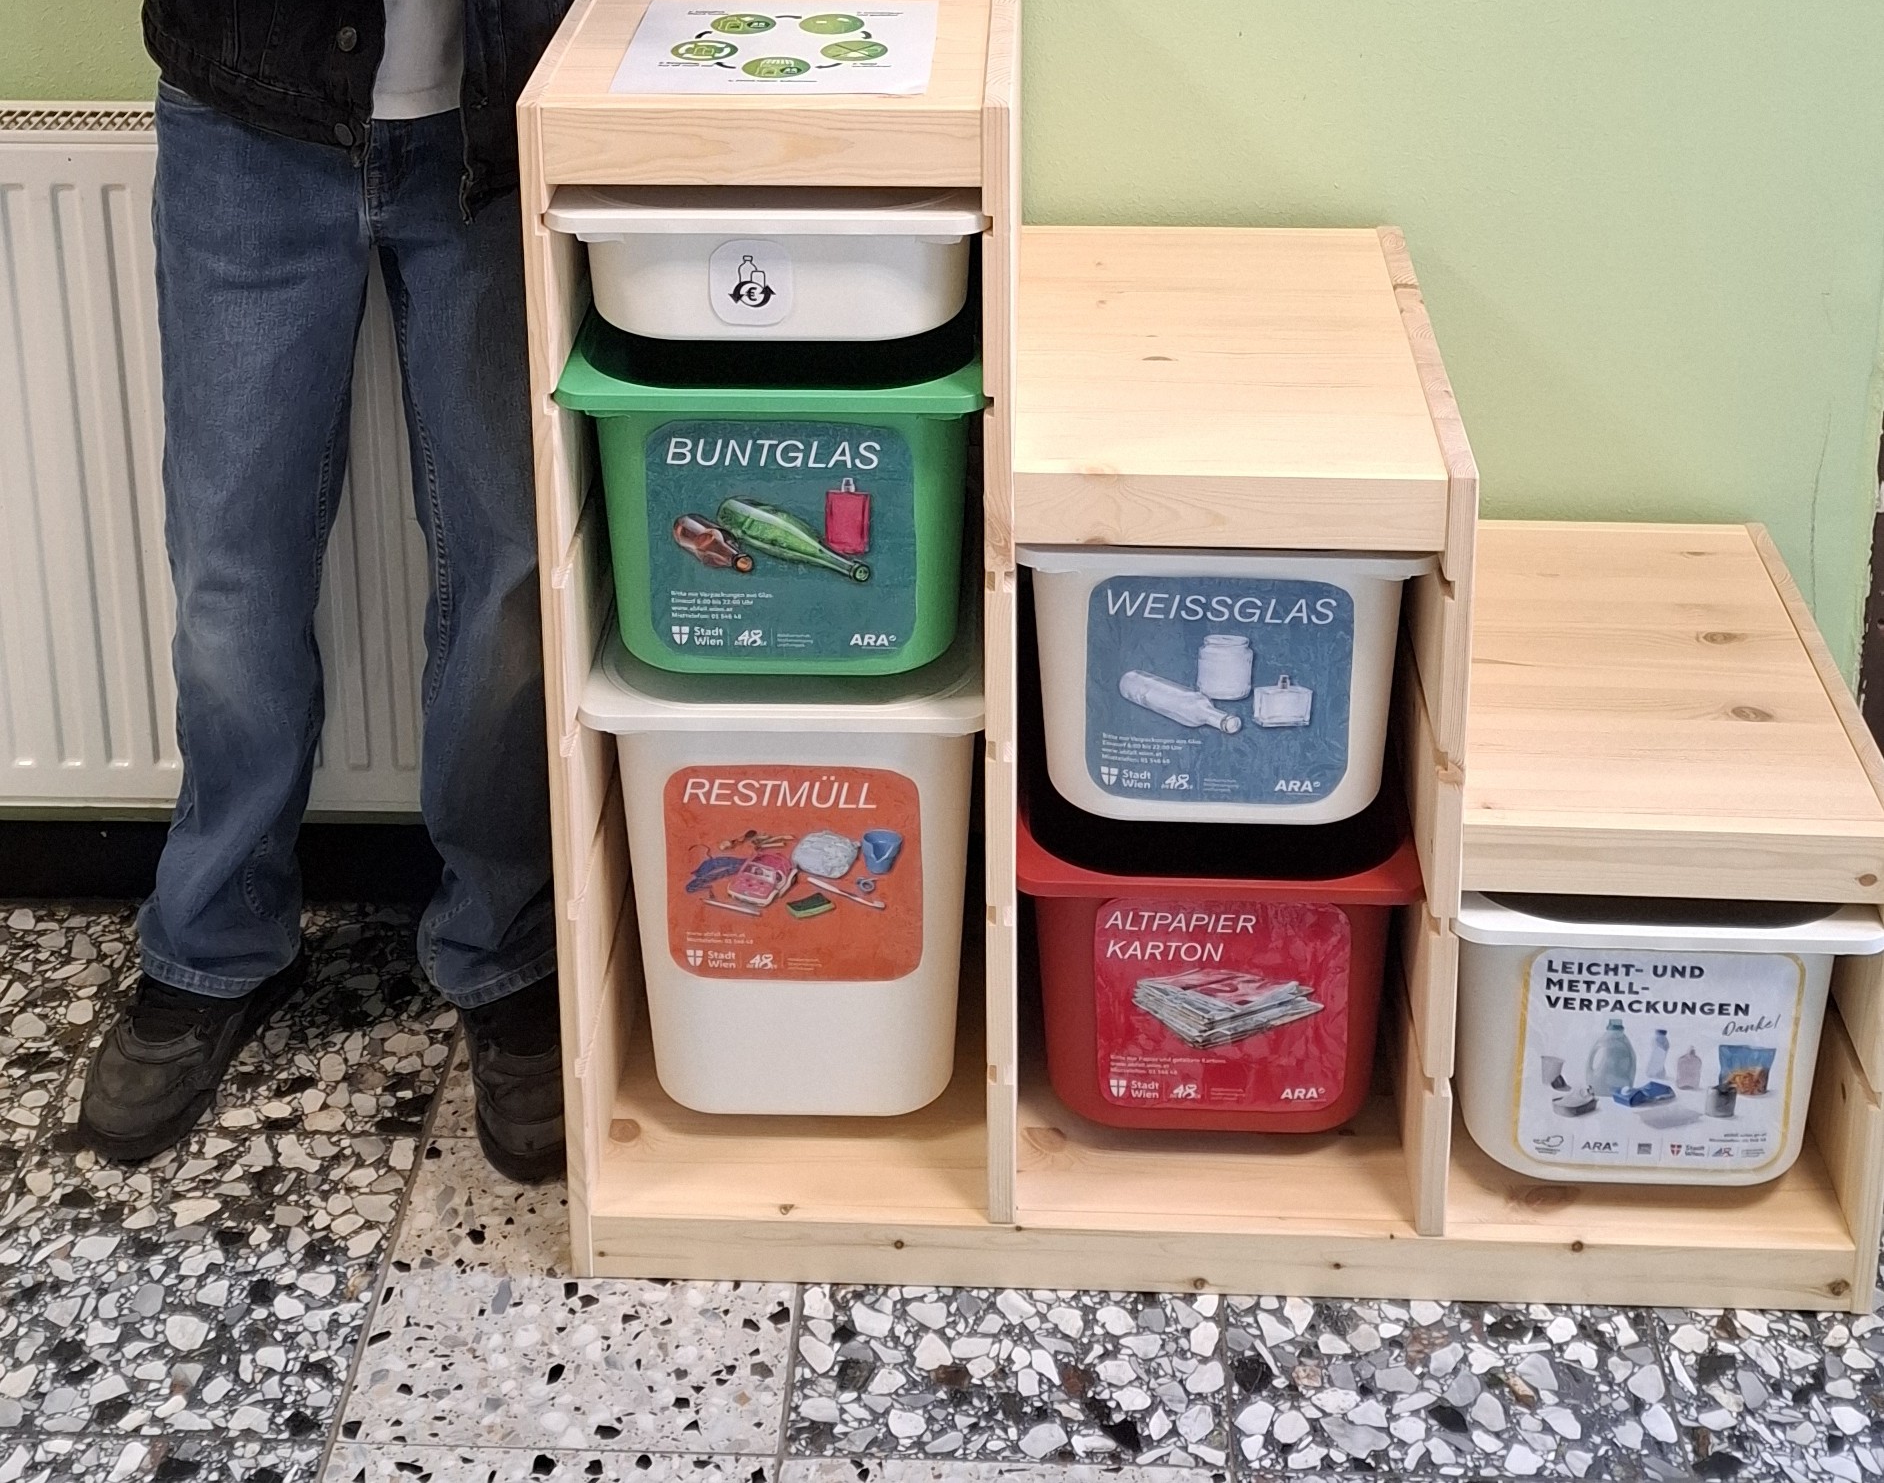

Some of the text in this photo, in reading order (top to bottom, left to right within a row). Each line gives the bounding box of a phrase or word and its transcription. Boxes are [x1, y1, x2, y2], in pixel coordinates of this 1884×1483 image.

[666, 437, 882, 470] BUNTGLAS
[1106, 588, 1338, 625] WEISSGLAS
[694, 626, 723, 636] Stadt
[694, 636, 724, 646] Wien
[850, 633, 890, 646] ARA
[1122, 769, 1151, 780] Stadt
[1122, 778, 1151, 789] Wien
[1274, 779, 1313, 792] ARA
[683, 775, 877, 809] RESTMÜLL
[1104, 910, 1257, 934] ALTPAPIER
[707, 950, 736, 960] Stadt
[1106, 940, 1224, 962] KARTON
[707, 959, 736, 969] Wien
[1546, 959, 1705, 979] LEICHT- UND
[1545, 977, 1650, 996] METALL-
[1545, 995, 1750, 1017] VERPACKUNGEN
[1721, 1014, 1782, 1036] Danke!
[1131, 1080, 1159, 1090] Stadt
[1131, 1089, 1159, 1099] Wien
[1280, 1087, 1319, 1100] ARA
[1581, 1141, 1612, 1151] ARA
